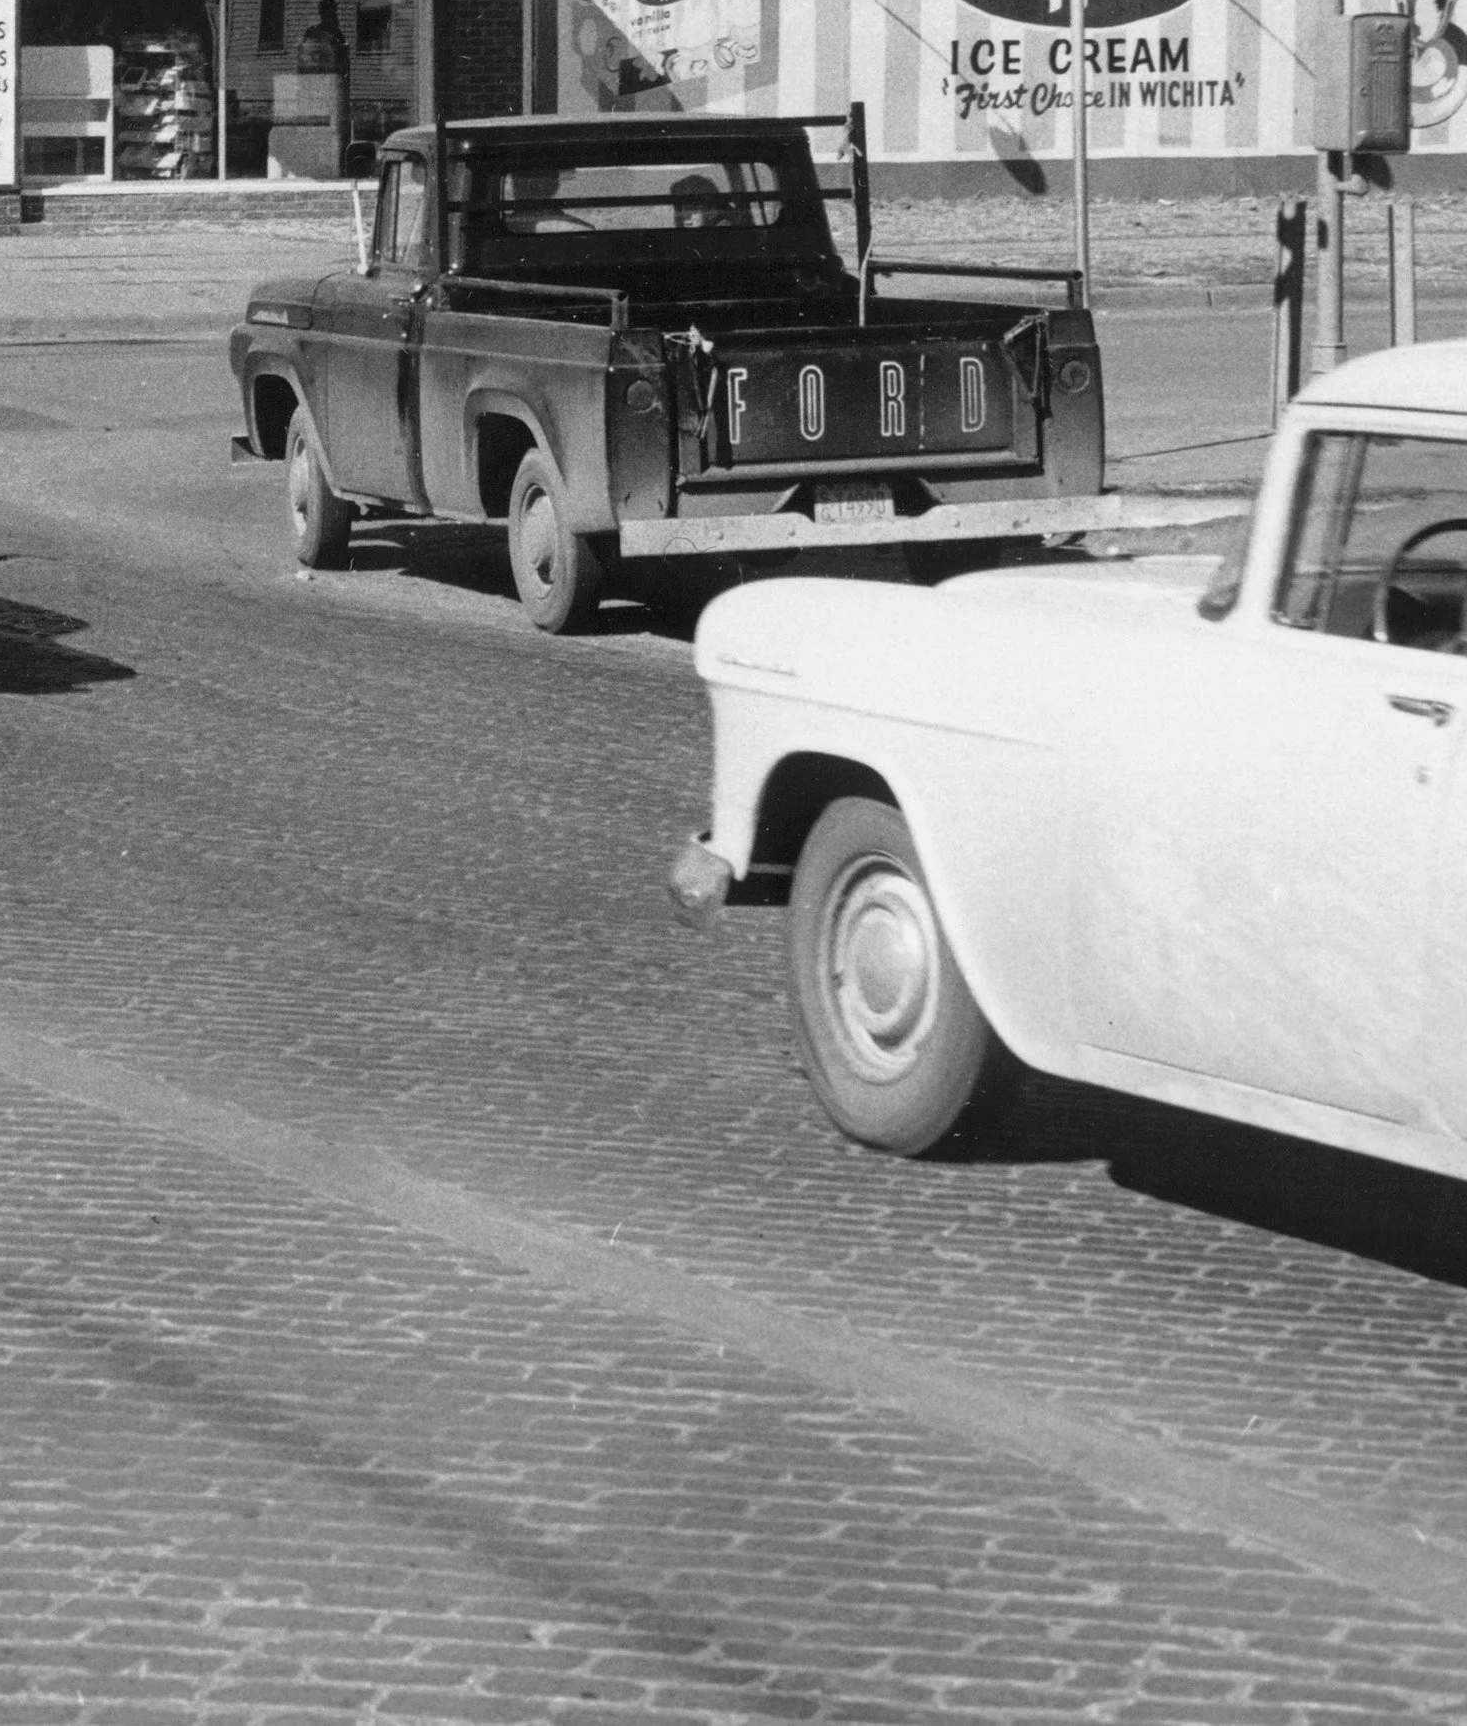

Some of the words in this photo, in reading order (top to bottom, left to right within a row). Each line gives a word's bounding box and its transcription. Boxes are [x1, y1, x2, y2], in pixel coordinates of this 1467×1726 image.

[950, 37, 1022, 76] ICE
[1030, 82, 1106, 116] Choce
[1110, 81, 1132, 108] IN
[727, 357, 986, 445] FORD
